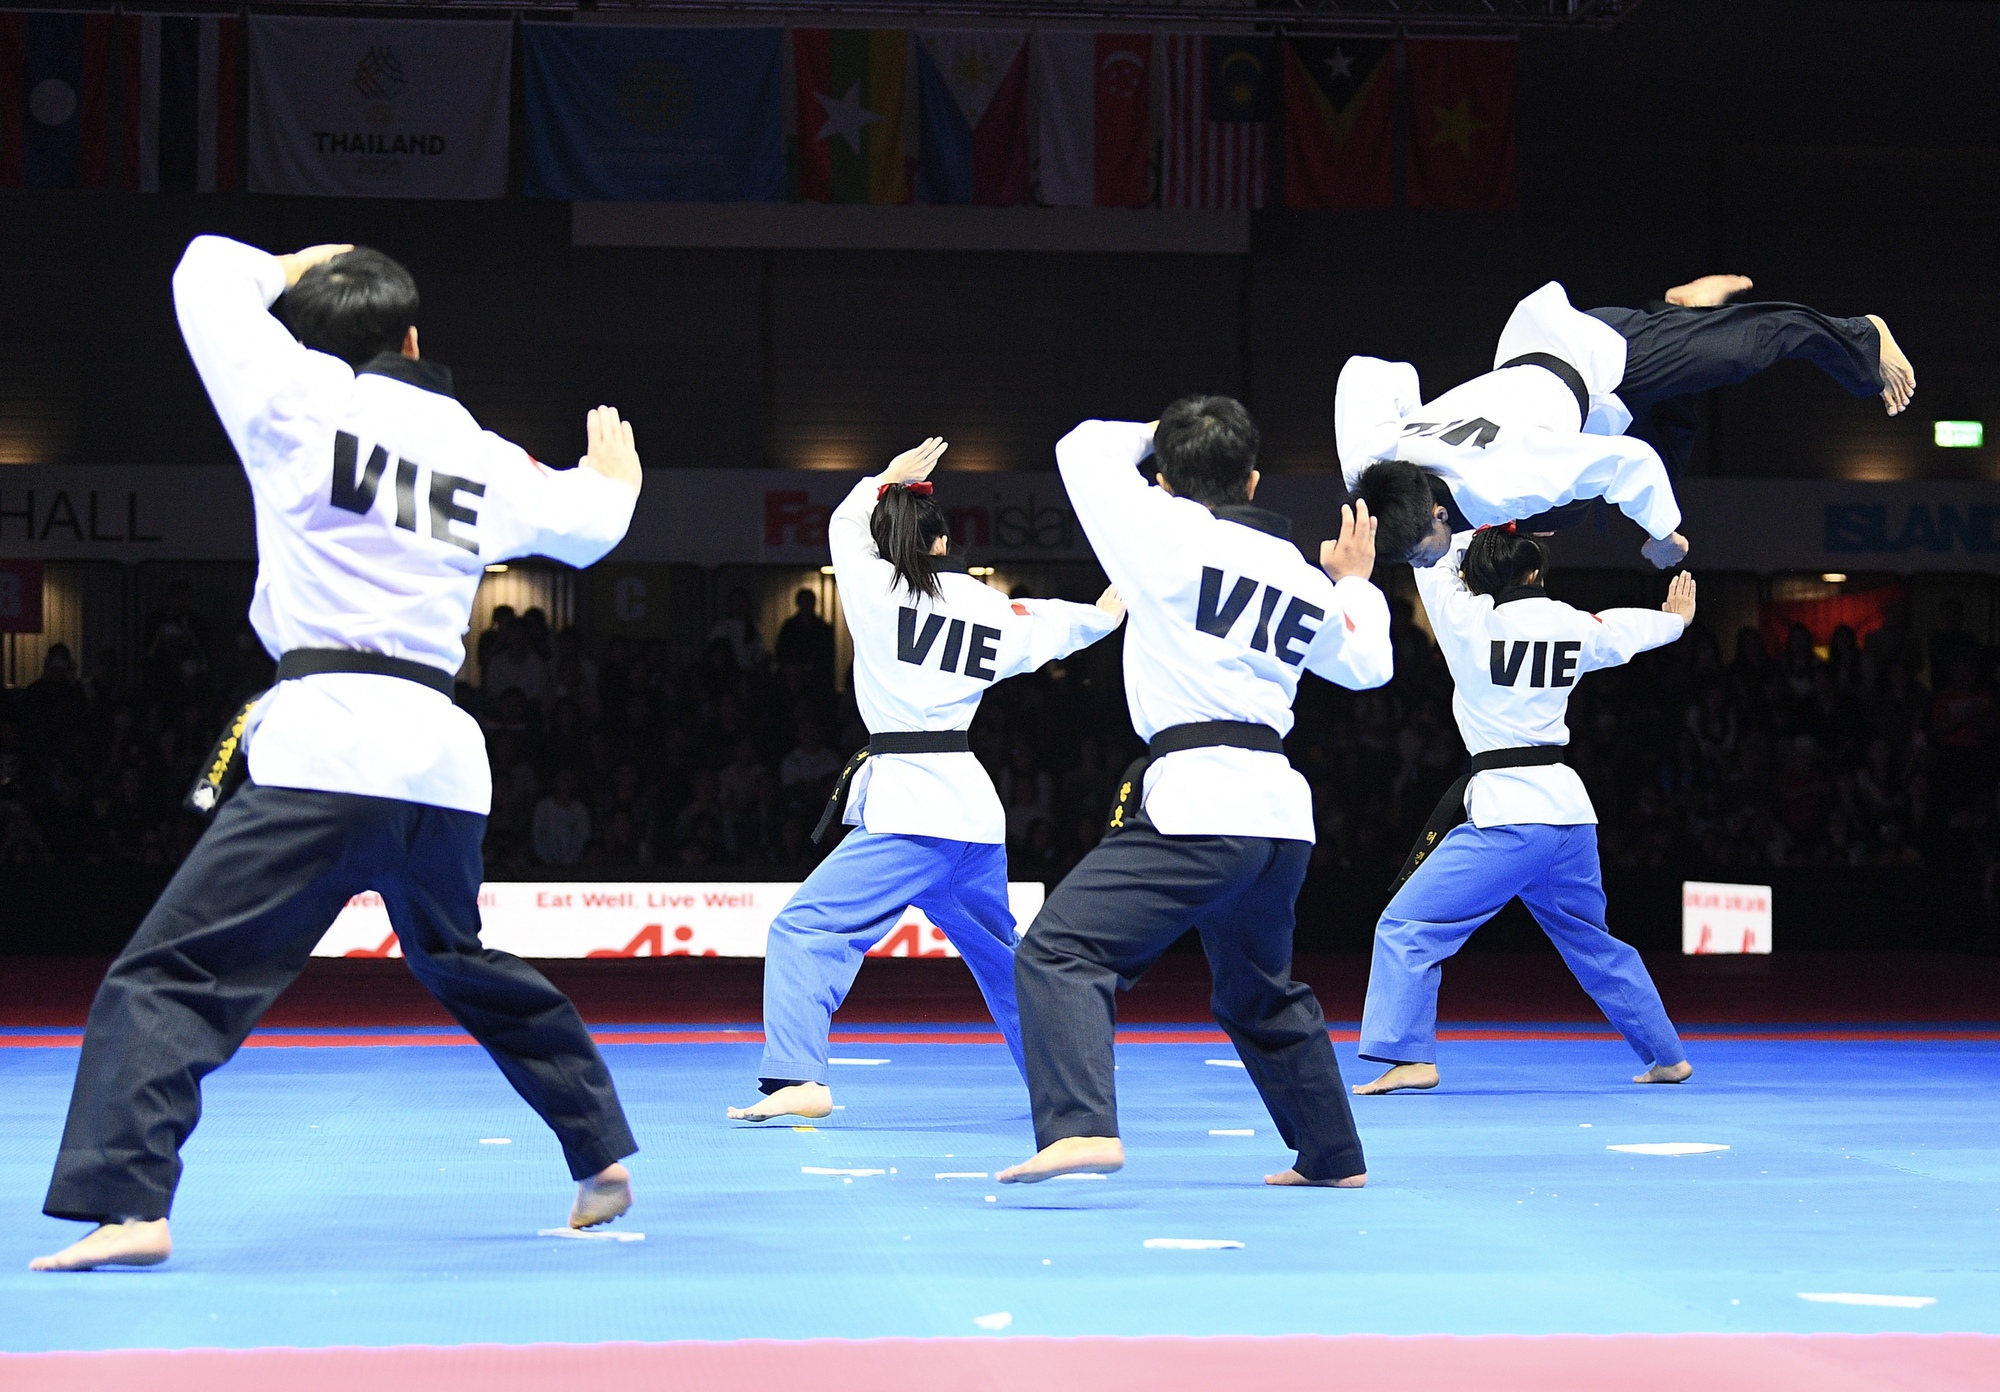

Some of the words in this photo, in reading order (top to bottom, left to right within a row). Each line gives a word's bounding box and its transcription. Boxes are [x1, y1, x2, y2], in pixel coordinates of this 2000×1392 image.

[313, 131, 446, 155] THAILAND
[330, 429, 486, 556] VIE
[615, 577, 647, 622] C
[1195, 565, 1326, 667] VIE
[897, 606, 1002, 682] VIE
[1489, 640, 1582, 688] VIE
[536, 891, 573, 908] Eat
[647, 891, 695, 908] Live
